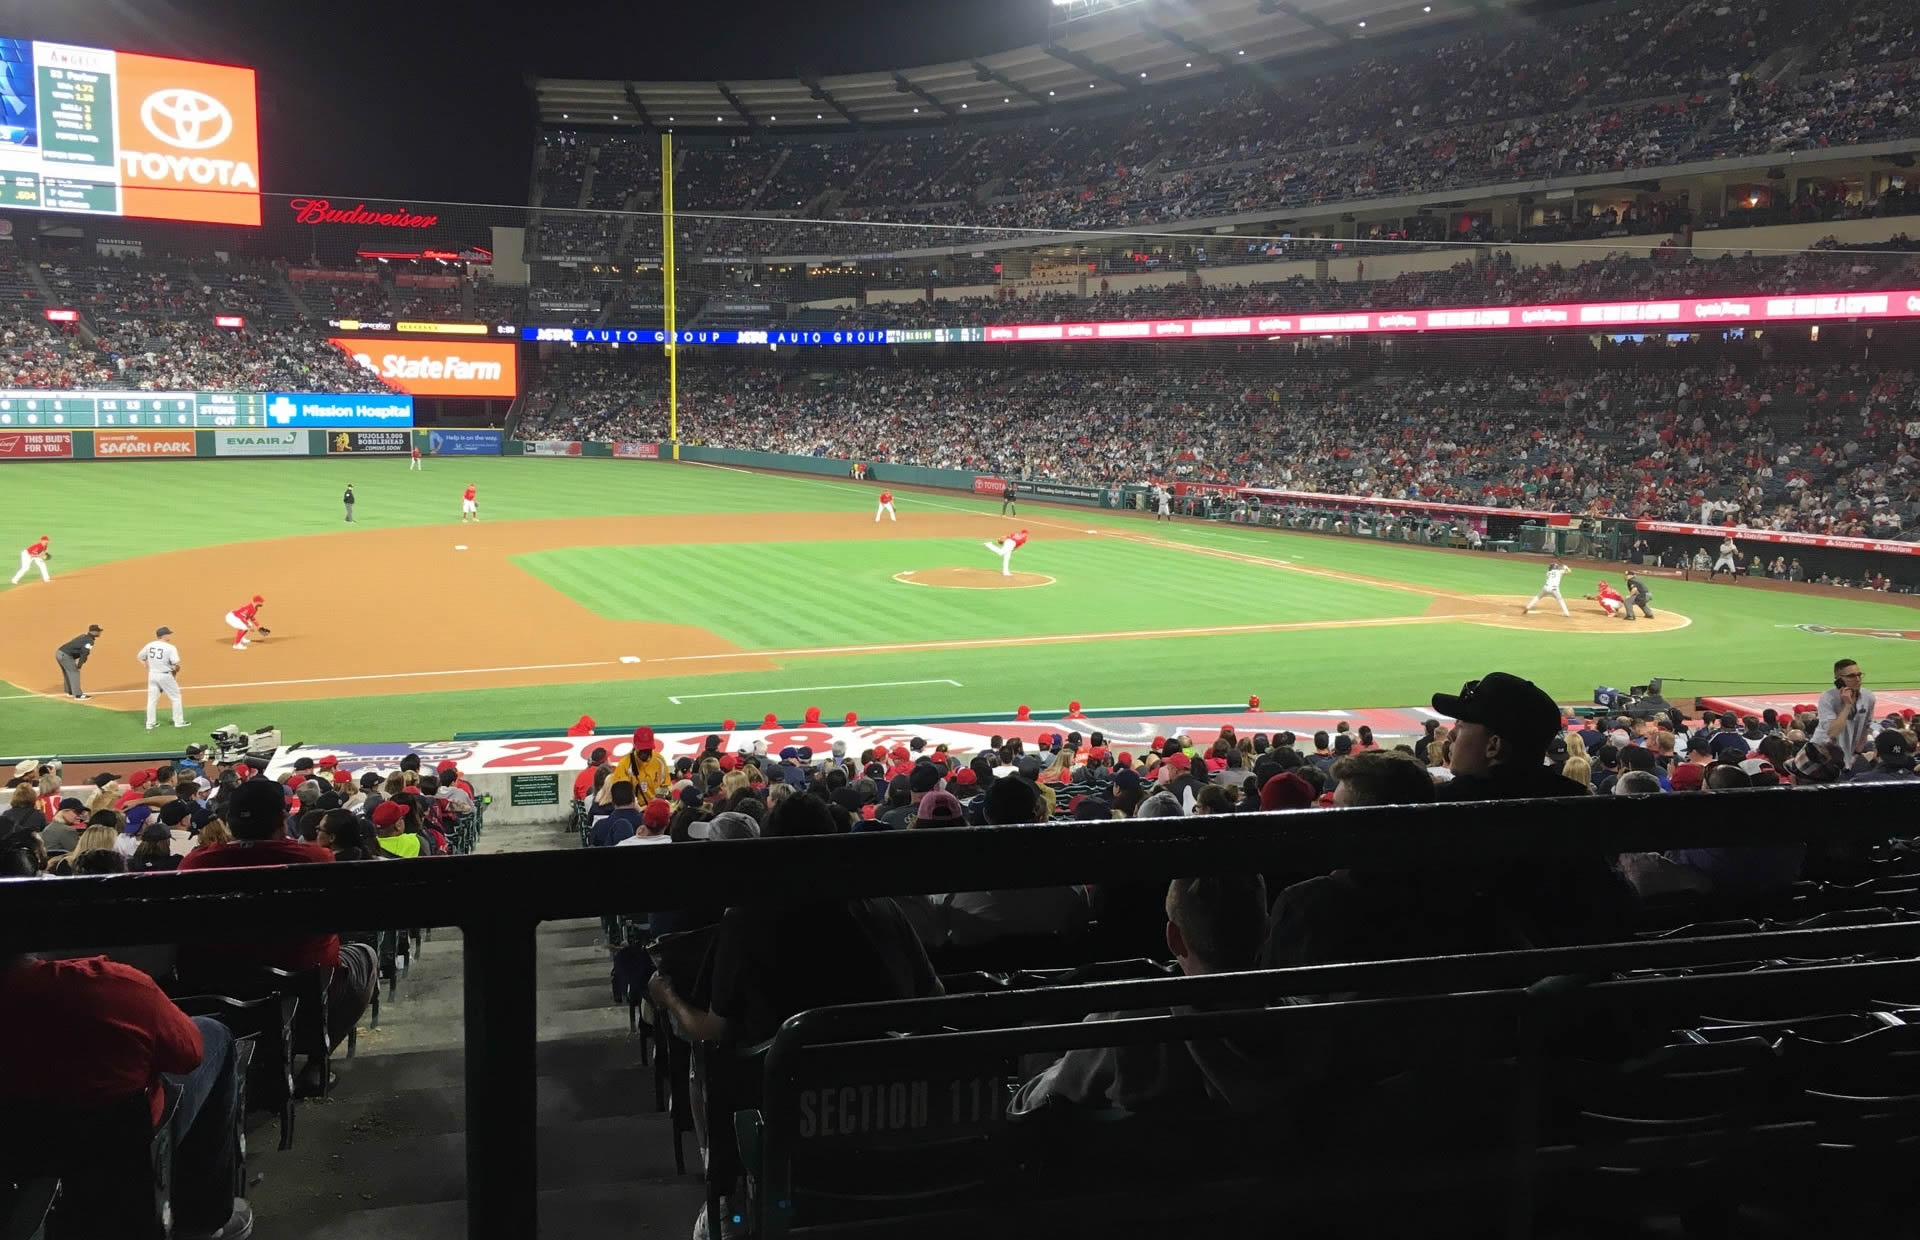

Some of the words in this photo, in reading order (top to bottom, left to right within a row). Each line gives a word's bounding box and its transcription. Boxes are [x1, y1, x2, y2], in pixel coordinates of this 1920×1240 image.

[120, 151, 257, 189] TOYOTA
[290, 199, 438, 228] Budweiser
[586, 330, 638, 341] AUTO
[655, 332, 720, 343] GROUP
[778, 332, 821, 344] AUTO
[834, 332, 884, 344] GROUP
[382, 353, 444, 379] State
[444, 356, 502, 380] Farm
[200, 405, 236, 415] STRIKE
[302, 405, 353, 417] Mission
[356, 404, 410, 419] Hospital
[215, 416, 236, 427] OUT
[24, 435, 43, 443] THIS
[45, 435, 70, 443] BUD'S
[227, 437, 254, 445] EVA
[25, 444, 41, 452] FOR
[43, 444, 62, 452] YOU.
[99, 442, 151, 453] SAFARI
[153, 441, 191, 452] PARK
[984, 481, 1006, 491] TOYOTA
[149, 647, 164, 659] 53
[800, 1080, 928, 1138] SECTION
[952, 1076, 1000, 1124] 111
